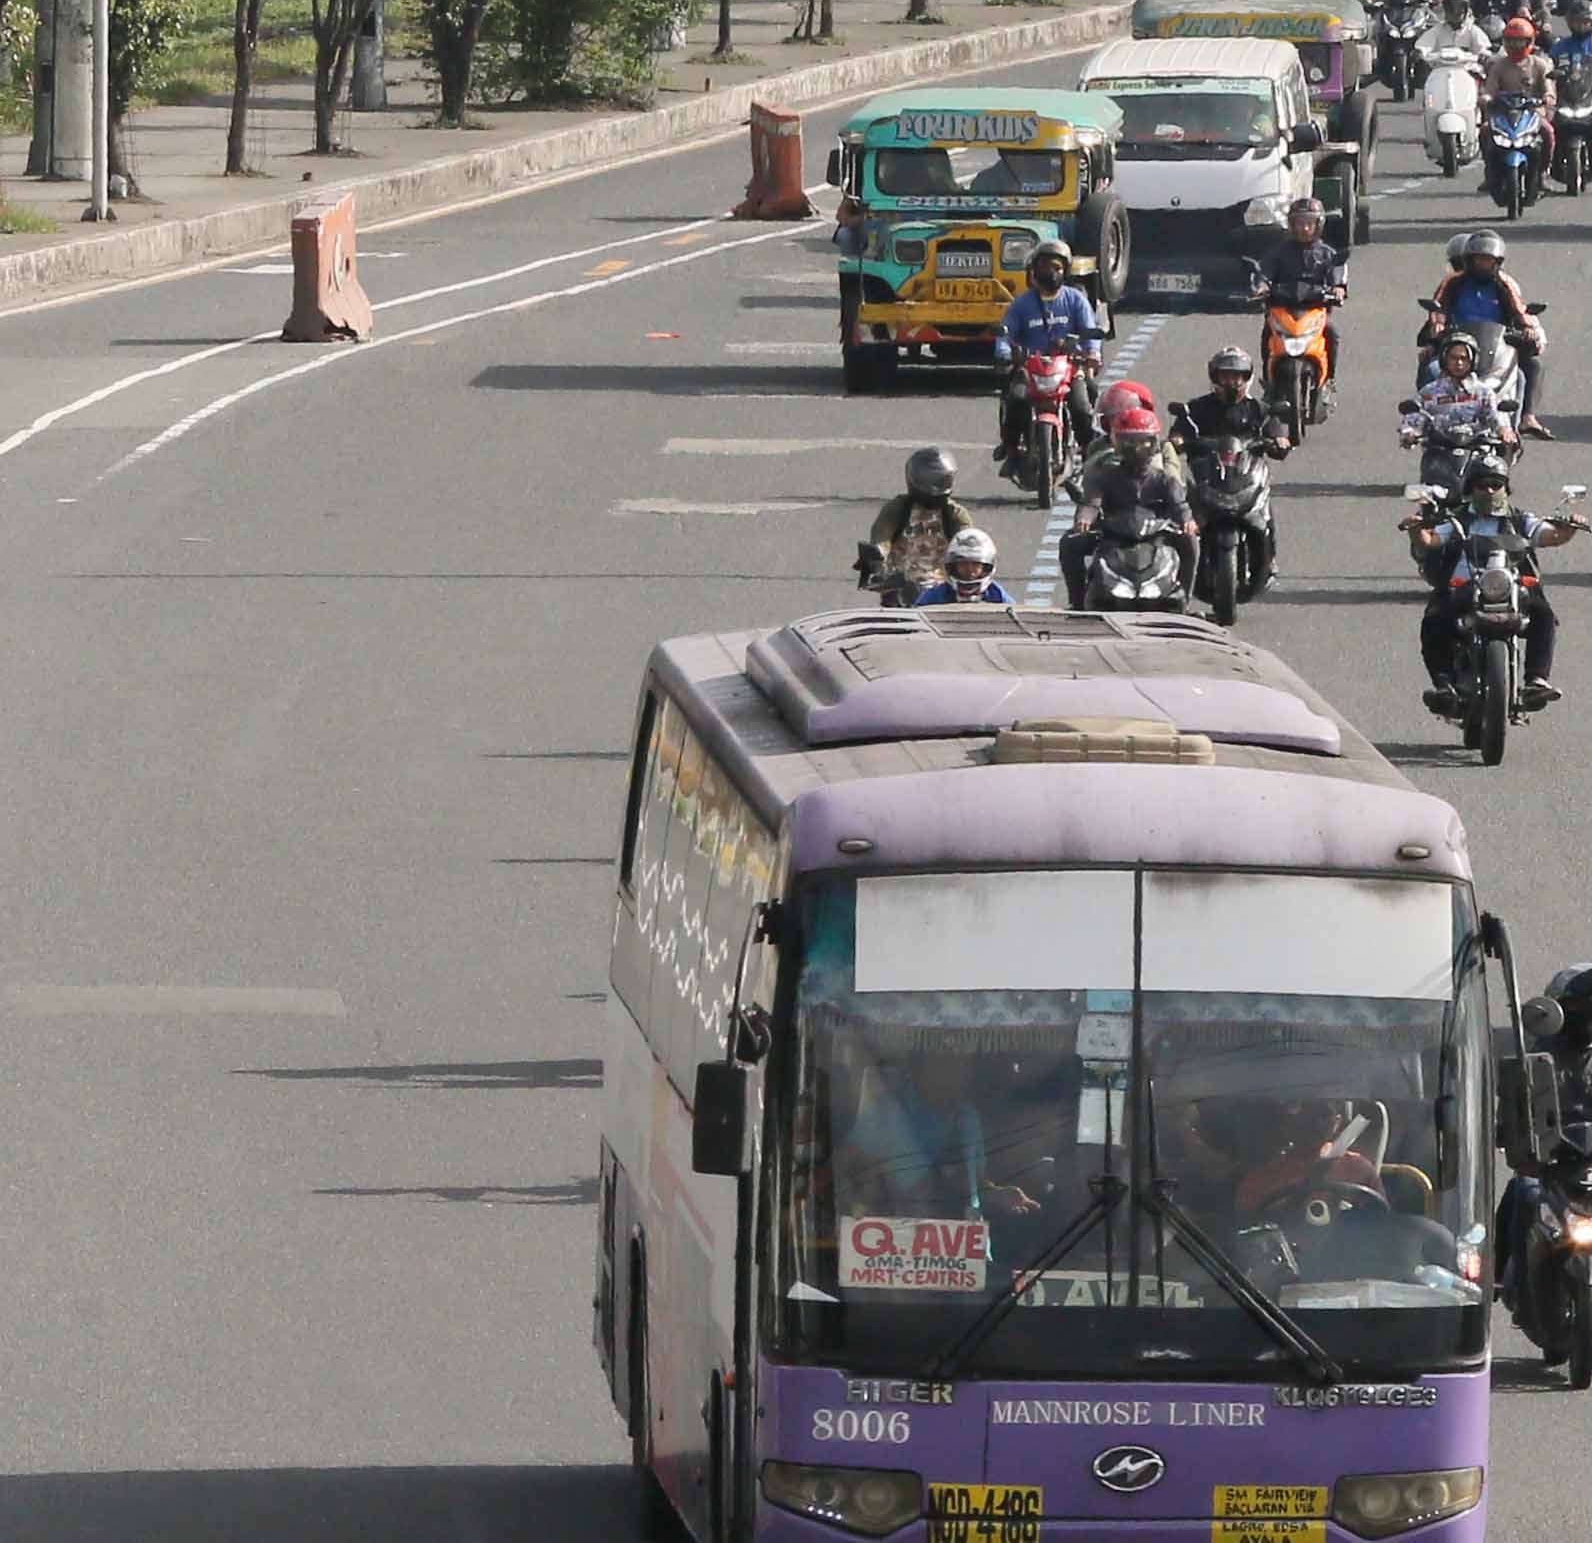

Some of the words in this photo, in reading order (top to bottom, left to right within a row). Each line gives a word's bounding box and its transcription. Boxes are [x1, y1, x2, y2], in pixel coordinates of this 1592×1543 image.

[977, 114, 1040, 144] KIDS
[850, 1268, 978, 1288] MRT-CENTRIS
[847, 1379, 953, 1404] HIGER
[991, 1400, 1151, 1426] MANNROSE
[1167, 1401, 1265, 1427] LINER
[811, 1408, 912, 1444] 8006
[1225, 1488, 1248, 1501] SM
[1255, 1488, 1318, 1502] FAIRVIEW
[1224, 1501, 1288, 1515] BACLARAN
[1294, 1503, 1315, 1514] VIA
[1273, 1521, 1309, 1533] EDSA
